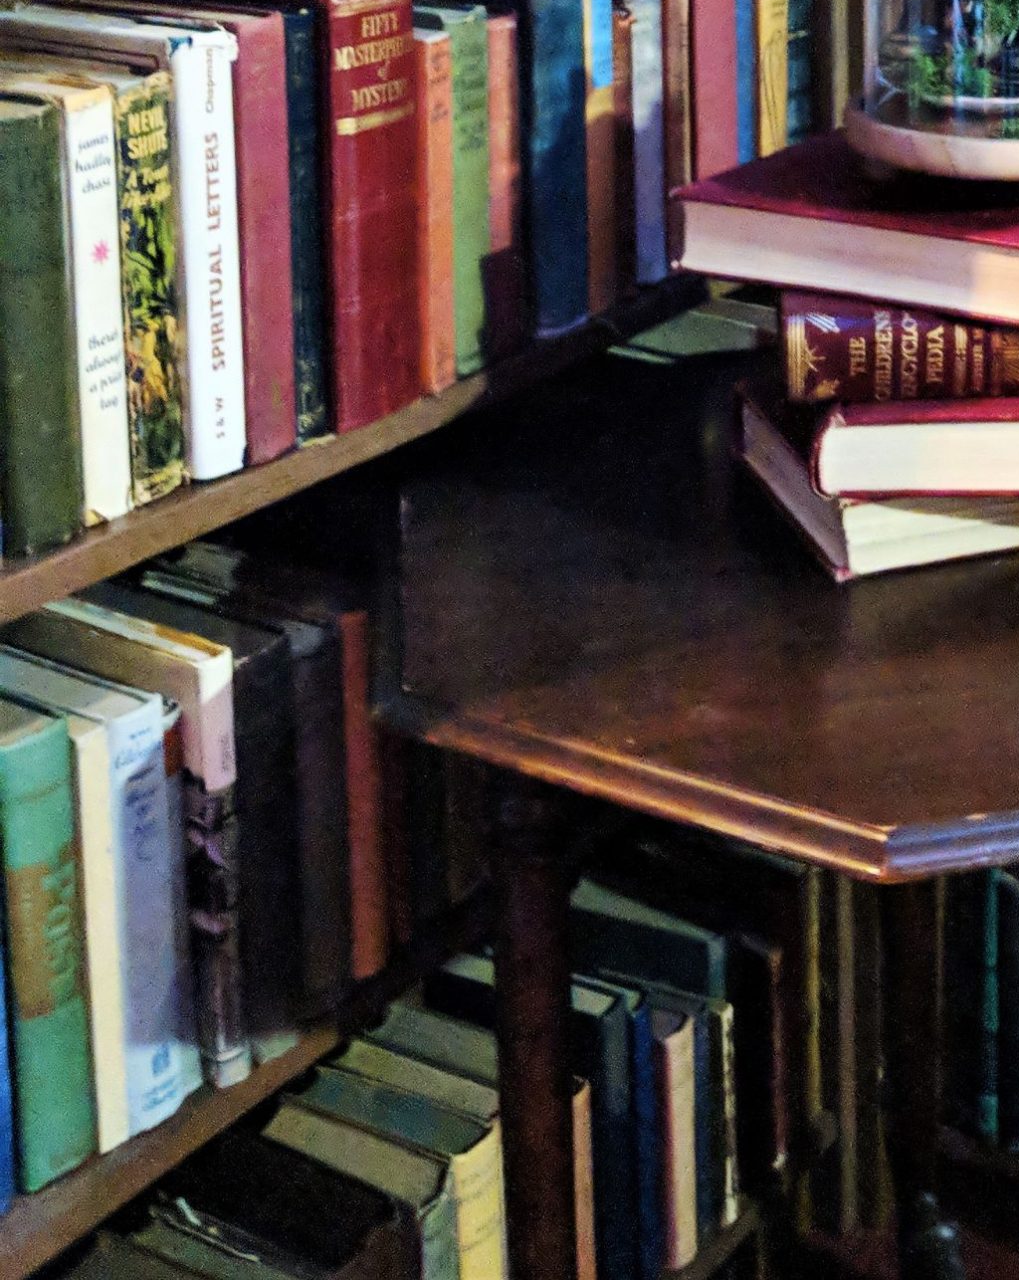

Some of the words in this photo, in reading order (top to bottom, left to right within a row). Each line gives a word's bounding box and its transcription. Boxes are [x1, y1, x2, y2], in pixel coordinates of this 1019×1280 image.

[361, 11, 399, 39] FIFTY
[204, 47, 217, 114] Chapman
[204, 131, 222, 231] LETTERS
[208, 244, 227, 372] SPIRITUAL
[849, 336, 867, 377] THE
[873, 309, 894, 401] CHILDREN'S
[926, 323, 945, 384] PEDIA
